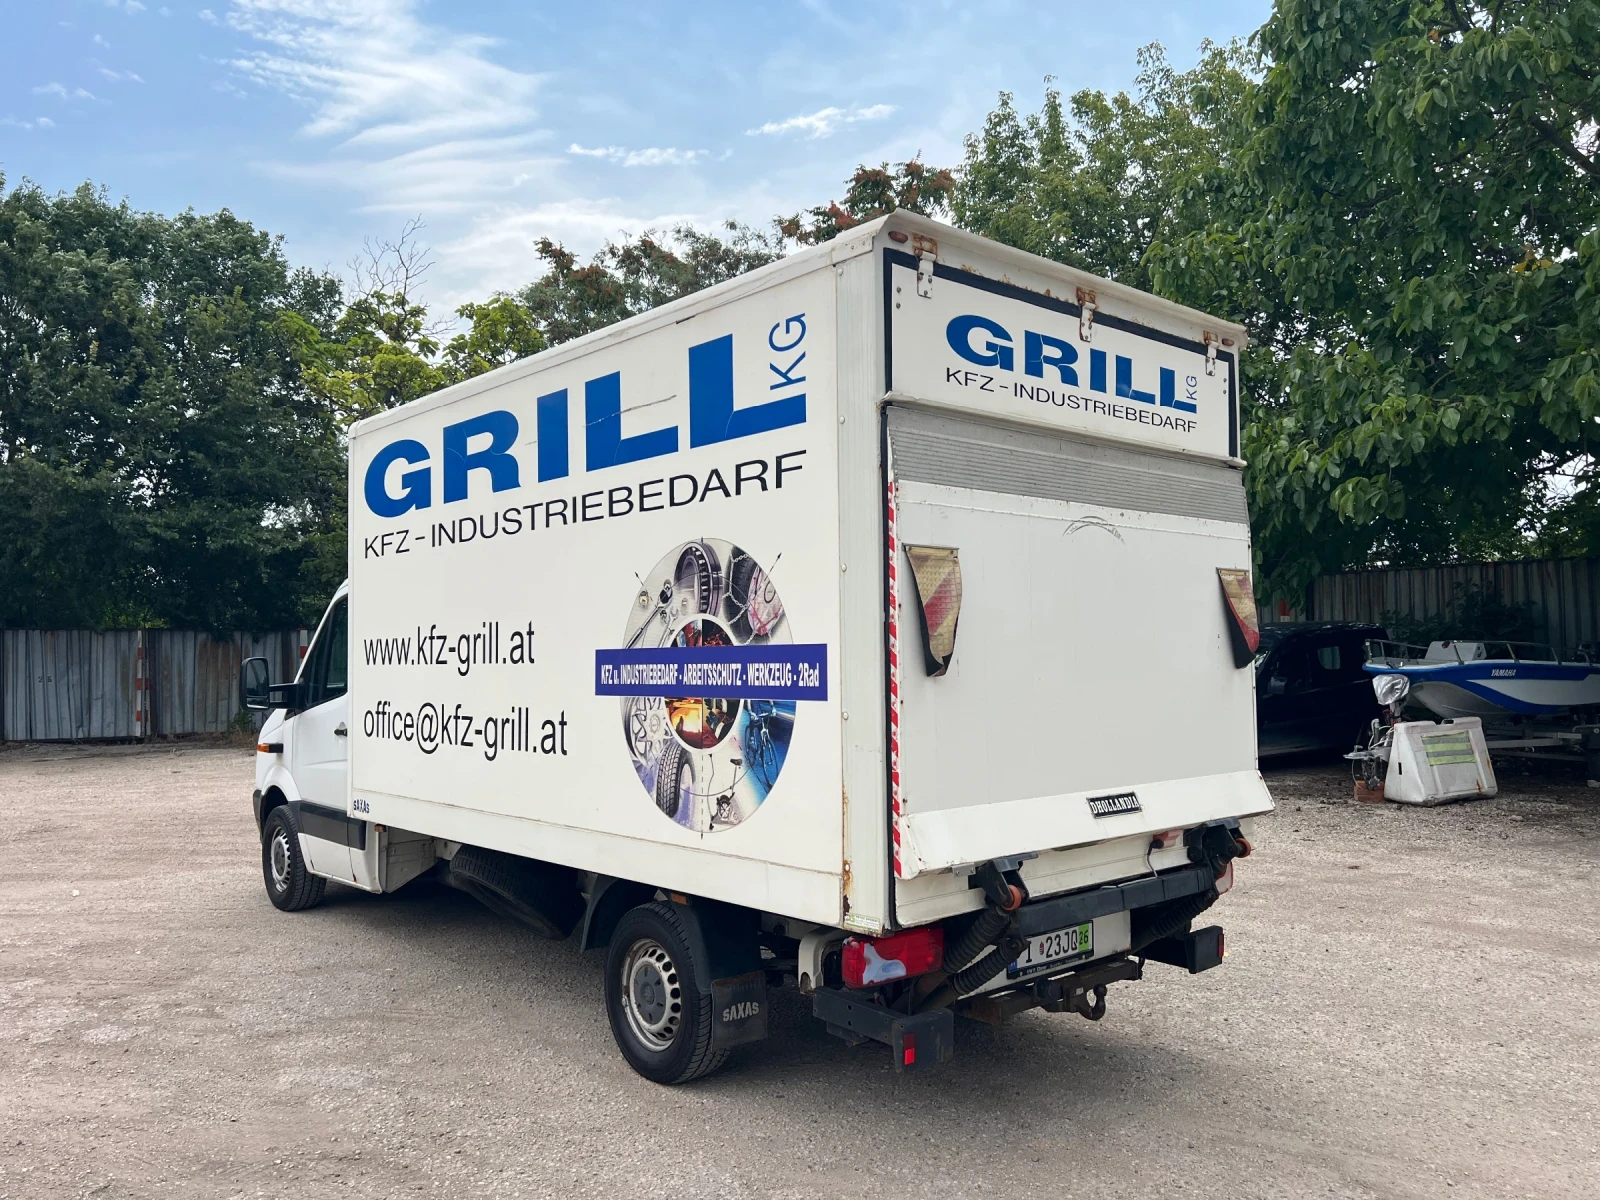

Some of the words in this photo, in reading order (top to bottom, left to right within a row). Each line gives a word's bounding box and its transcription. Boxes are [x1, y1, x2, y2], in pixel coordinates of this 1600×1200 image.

[768, 313, 807, 391] KG
[946, 314, 1197, 414] GRILL
[1185, 374, 1198, 401] KG
[364, 333, 807, 518] GRILL
[364, 621, 535, 677] www.kfz-grill.at
[601, 664, 613, 685] KFZ
[620, 663, 678, 685] INDUSTRIEBEDARF
[683, 663, 742, 686] ARBEITSSCHUTZ
[747, 662, 792, 687] WERKZEUG
[798, 662, 820, 688] 2Rad
[1491, 668, 1516, 677] YAMAHA
[364, 700, 568, 761] office@kfz-grill.at
[1090, 795, 1140, 814] DHOLLANDIA
[722, 1001, 760, 1022] SAXAS
